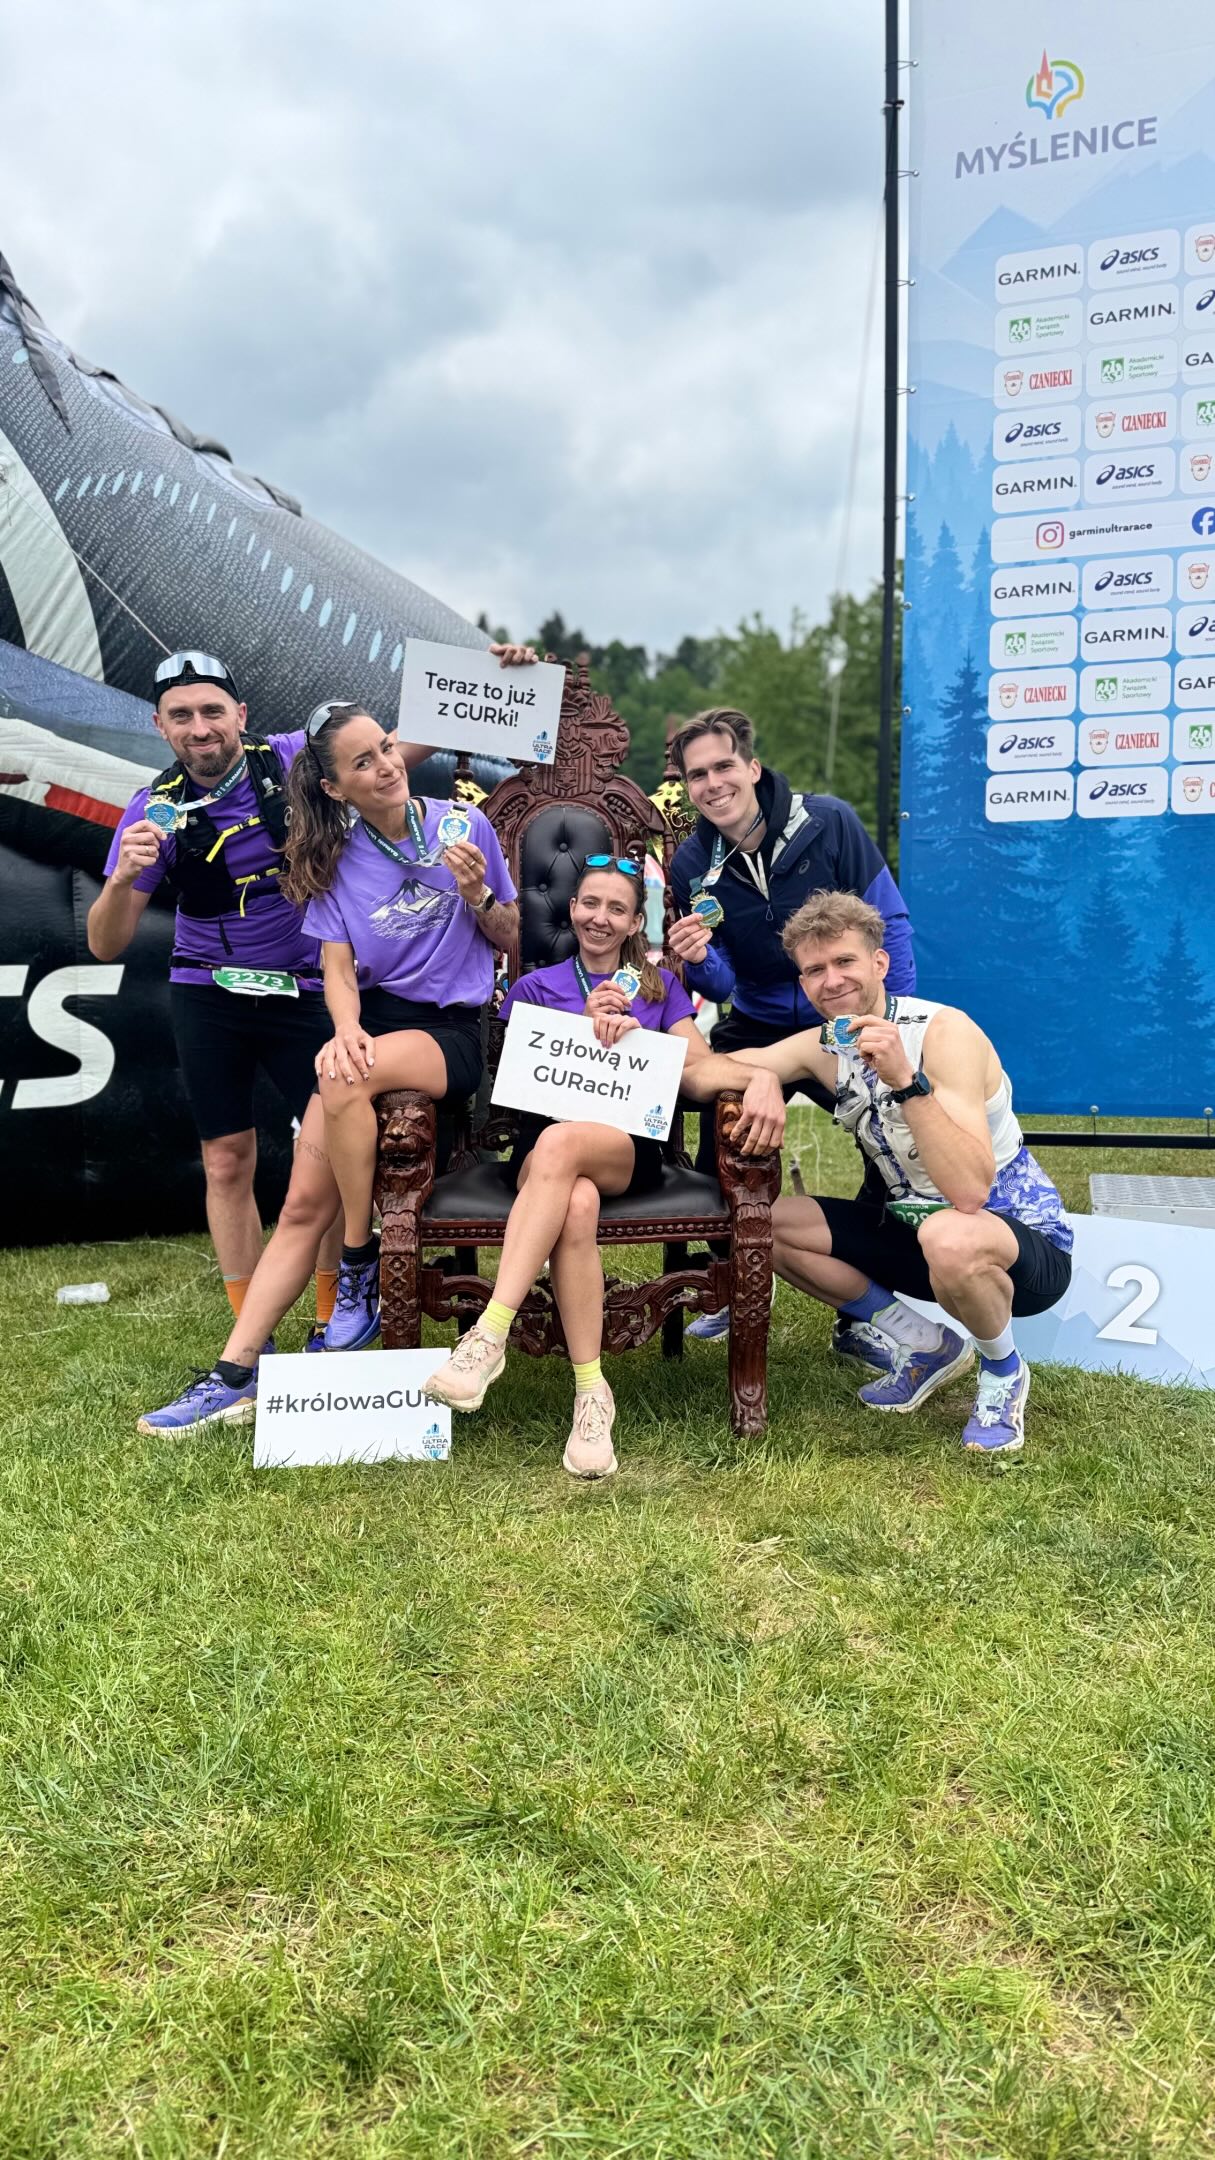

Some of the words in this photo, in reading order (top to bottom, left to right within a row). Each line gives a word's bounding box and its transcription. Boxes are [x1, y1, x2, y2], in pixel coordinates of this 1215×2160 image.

[955, 117, 1158, 179] MYŚLENICE
[1029, 369, 1073, 390] CZANIECKI
[1122, 411, 1167, 432] CZANIECKI
[1069, 522, 1153, 540] garminultrarace
[425, 671, 478, 697] Teraz
[483, 682, 503, 700] to
[505, 684, 537, 706] już
[1024, 685, 1067, 704] CZANIECKI
[437, 702, 449, 716] z
[453, 702, 519, 728] GURki!
[1115, 732, 1159, 750] CZANIECKI
[227, 972, 284, 987] 2273
[527, 1030, 546, 1049] Z
[549, 1038, 621, 1071] głową
[628, 1056, 650, 1072] w
[533, 1065, 632, 1101] GURach!
[643, 1117, 668, 1126] ULTRA
[645, 1121, 666, 1130] RACE
[1095, 1264, 1160, 1345] 2
